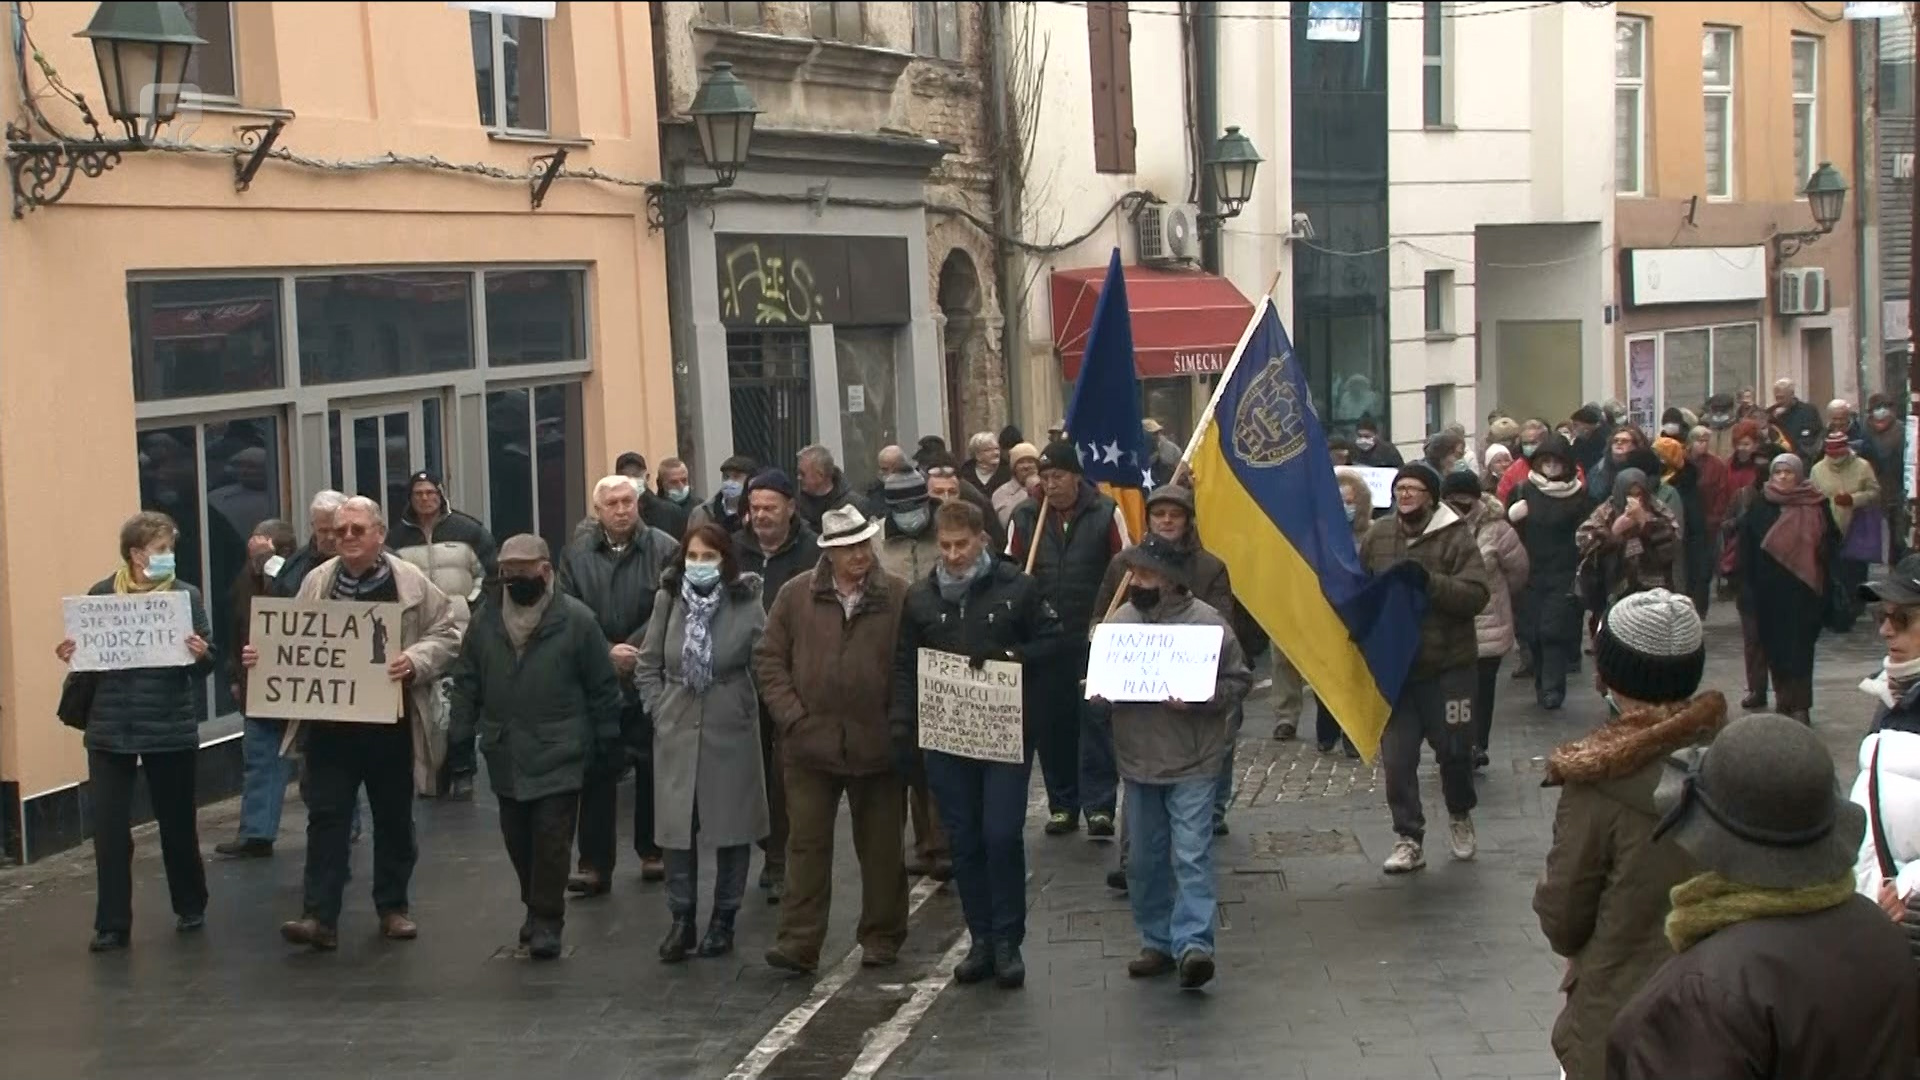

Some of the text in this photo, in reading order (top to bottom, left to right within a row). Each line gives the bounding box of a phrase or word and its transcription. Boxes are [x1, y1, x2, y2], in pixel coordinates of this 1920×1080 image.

[1174, 352, 1223, 372] ŠIMECKI
[258, 610, 359, 640] TUZLA
[277, 640, 347, 668] NEĆE
[266, 675, 356, 706] STATI
[1446, 699, 1473, 724] 86
